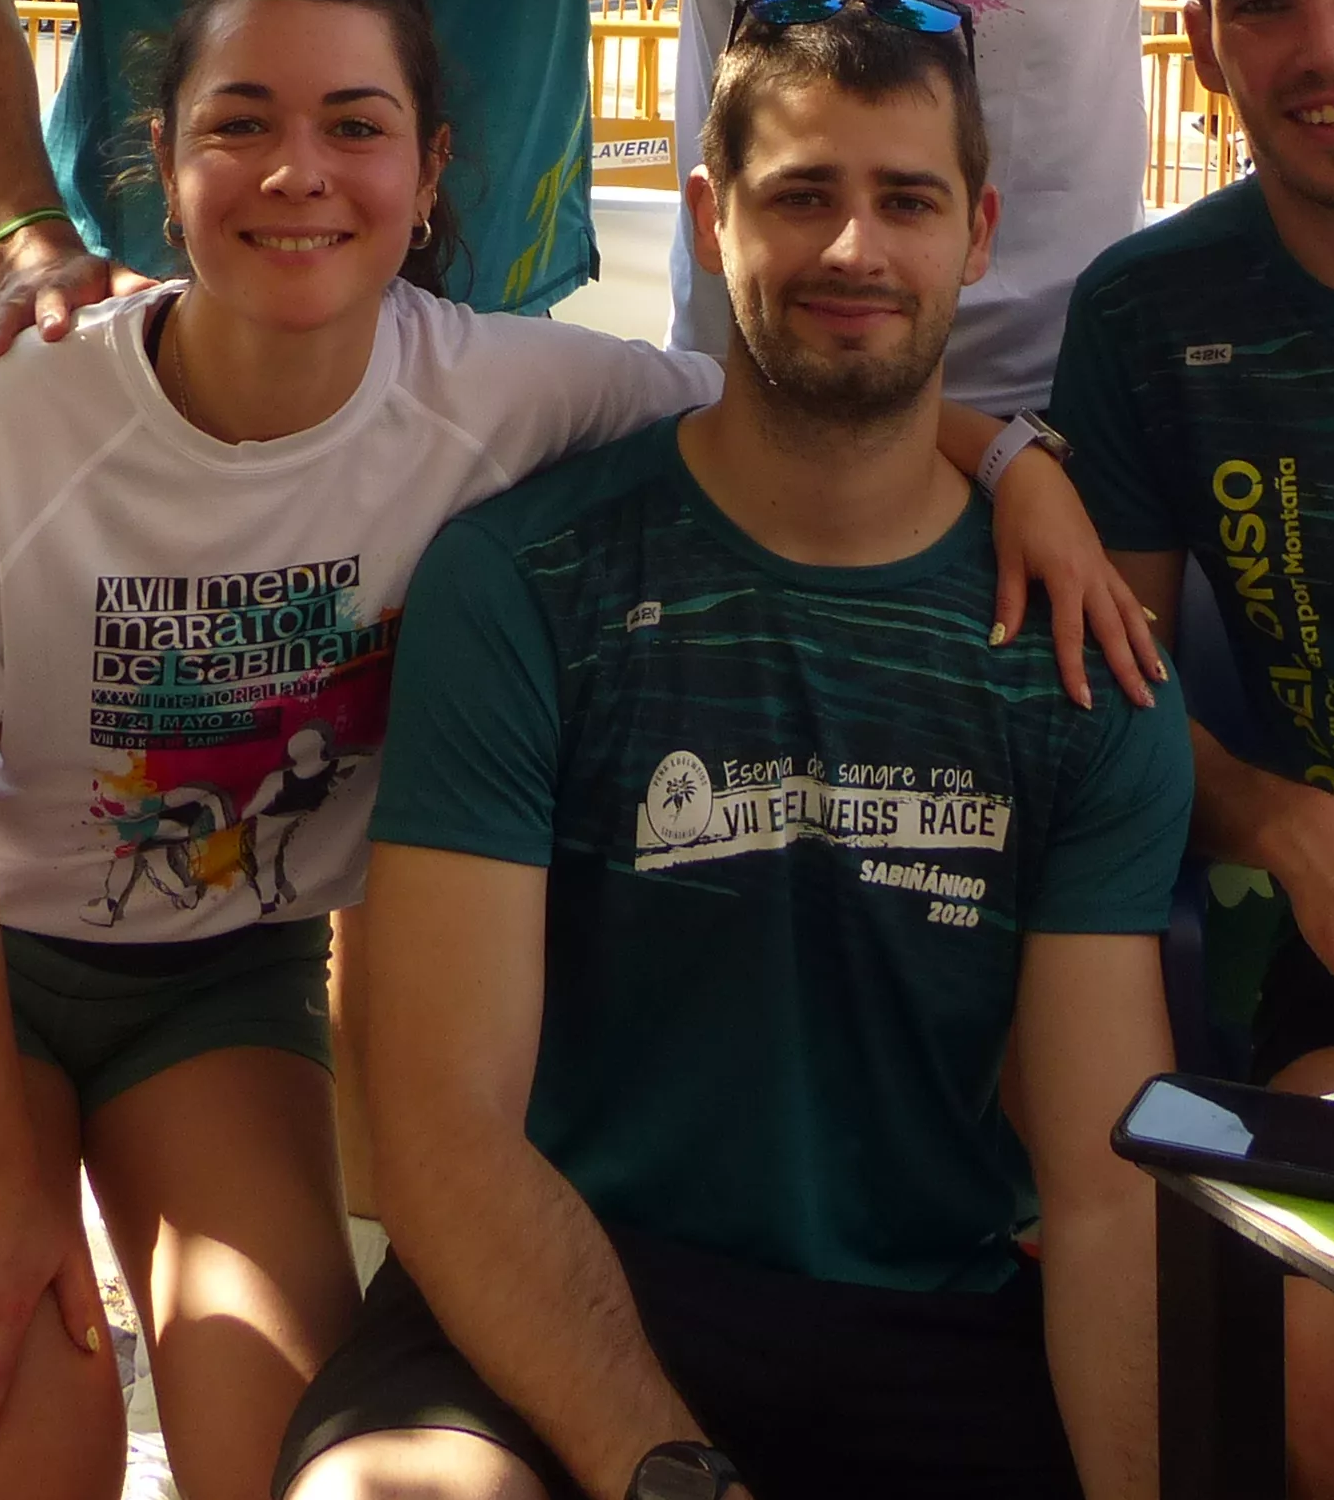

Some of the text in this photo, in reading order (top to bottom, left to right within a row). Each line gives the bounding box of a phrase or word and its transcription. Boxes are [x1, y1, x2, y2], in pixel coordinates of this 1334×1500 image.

[592, 139, 669, 159] AVERIA
[1272, 456, 1306, 574] Montaña
[1288, 574, 1321, 622] por
[94, 711, 149, 729] 23/24
[163, 714, 223, 729] MAYO
[838, 763, 916, 791] sangre
[930, 765, 974, 794] roja
[919, 801, 997, 838] RACE
[859, 859, 986, 901] SABIÑÁNIGO
[927, 901, 980, 928] 2026
